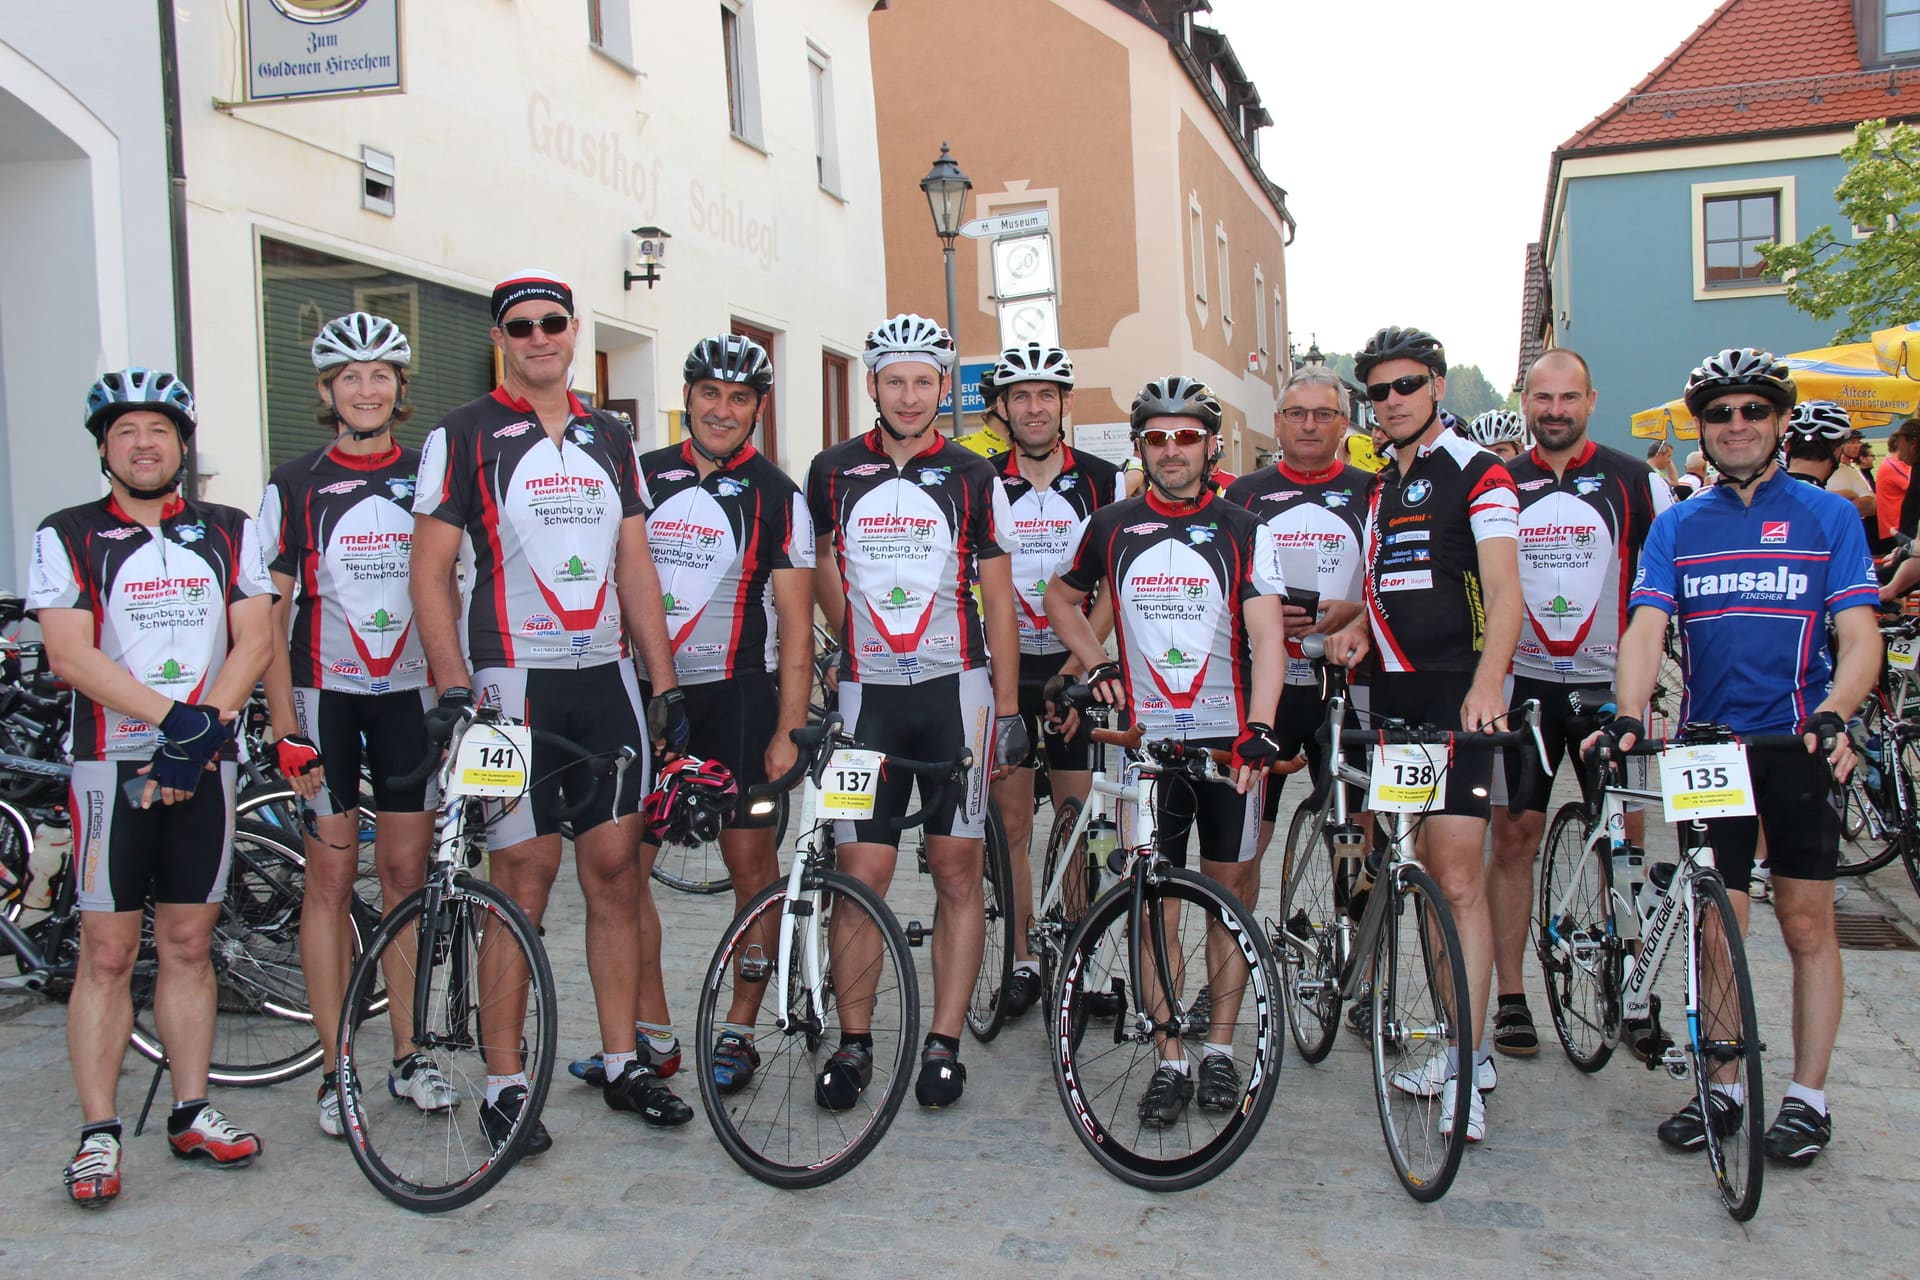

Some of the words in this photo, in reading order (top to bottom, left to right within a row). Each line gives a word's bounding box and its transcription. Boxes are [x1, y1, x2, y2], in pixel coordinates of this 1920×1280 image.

[306, 32, 338, 54] Zum
[258, 60, 321, 79] Goldenen
[528, 90, 663, 221] Gasthof
[689, 177, 780, 271] Schlegl
[1001, 217, 1038, 230] Museum
[525, 472, 604, 490] meixner
[534, 487, 577, 496] touristik
[535, 506, 583, 517] Neunburg
[544, 515, 601, 526] Schwandorf
[858, 513, 938, 529] meixner
[650, 519, 725, 538] meixner
[653, 530, 693, 540] touristik
[864, 526, 907, 534] touristik
[1519, 523, 1597, 537] meixner
[1525, 535, 1567, 543] touristik
[347, 543, 390, 552] touristik
[862, 543, 911, 554] Neunburg
[653, 555, 709, 571] Schwandorf
[870, 552, 928, 561] Schwandorf
[1525, 552, 1572, 562] Neunburg
[346, 562, 395, 573] Neunburg
[1532, 559, 1589, 569] Schwandorf
[354, 570, 409, 580] Schwandor
[1131, 573, 1210, 587] meixner
[124, 577, 210, 593] meixner
[1136, 585, 1179, 593] touristik
[1683, 566, 1808, 601] transalp
[132, 589, 178, 601] touristik
[1740, 592, 1783, 601] FINISHER
[131, 607, 185, 623] Neunburg
[1136, 603, 1184, 614] Neunburg
[1375, 597, 1389, 620] 2011
[1143, 611, 1201, 621] Schwandorf
[139, 619, 205, 631] Schwandorf
[480, 747, 514, 768] 141
[836, 771, 871, 792] 137
[1394, 765, 1432, 786] 138
[1682, 767, 1728, 790] 135
[970, 766, 981, 816] Fitness
[92, 790, 104, 840] Fitness
[1631, 895, 1675, 993] cannondale
[343, 1055, 359, 1126] EASTON
